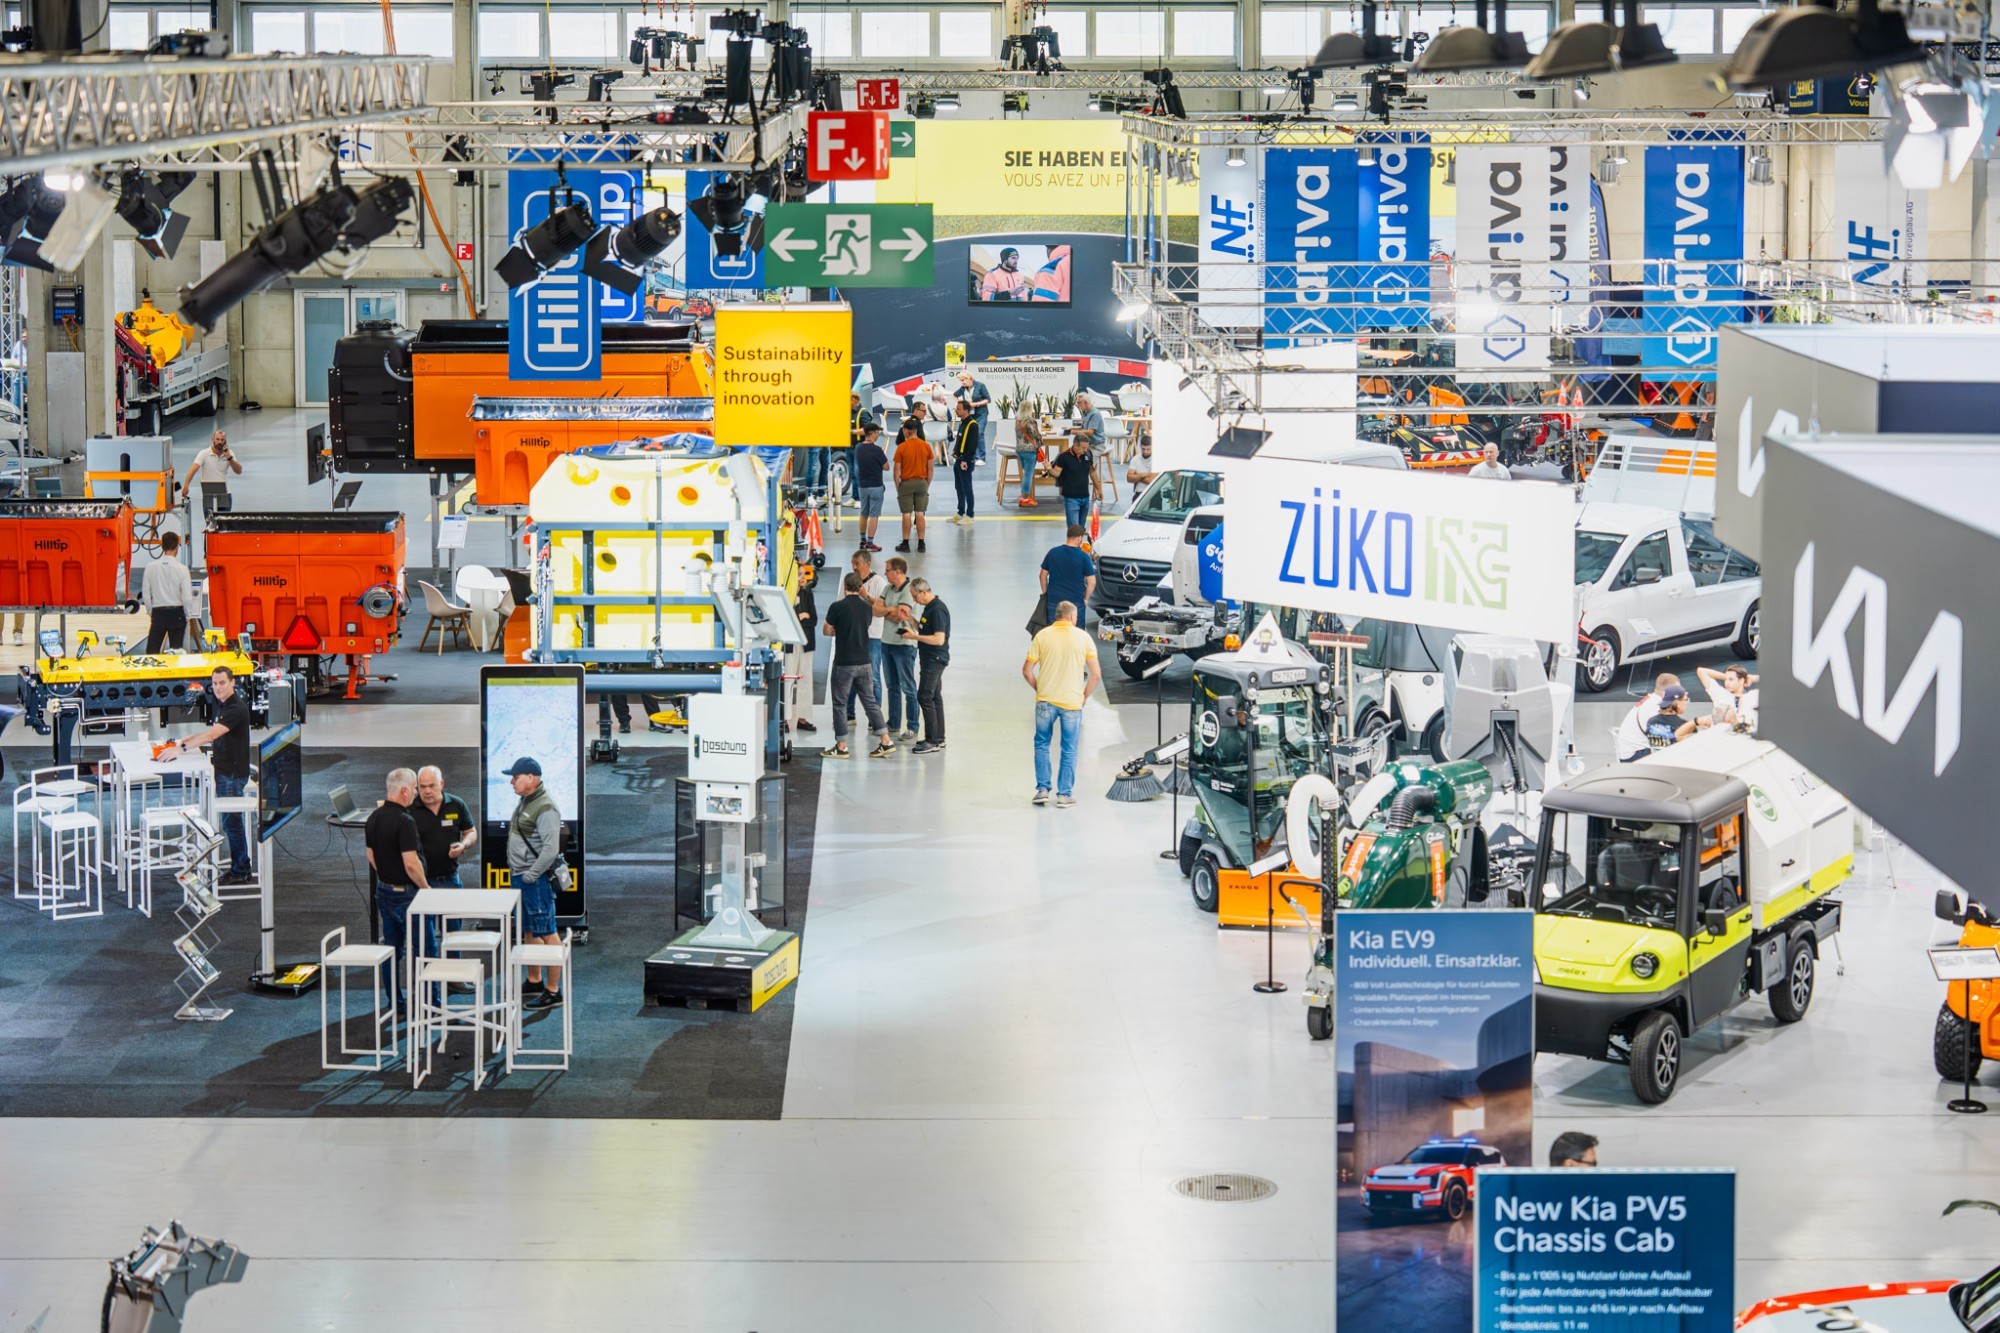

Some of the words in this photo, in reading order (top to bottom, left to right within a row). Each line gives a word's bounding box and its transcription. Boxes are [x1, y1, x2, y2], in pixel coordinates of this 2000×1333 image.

[860, 83, 869, 106] F
[881, 82, 890, 106] F
[817, 119, 846, 171] F
[876, 118, 884, 170] F
[1005, 151, 1032, 167] SIE
[1039, 151, 1104, 167] HABEN
[1005, 173, 1042, 187] VOUS
[1048, 173, 1084, 187] AVEZ
[1090, 173, 1110, 187] UN
[459, 245, 466, 258] F
[723, 346, 843, 364] Sustainability
[723, 369, 792, 386] through
[723, 391, 815, 405] innovation
[520, 437, 550, 449] Hilltip
[34, 538, 68, 552] Hilltip
[1279, 487, 1412, 598] ZÜKO
[253, 575, 287, 589] Hilltip
[702, 739, 747, 755] boschung
[1350, 930, 1384, 949] Kia
[1391, 930, 1436, 949] EV9
[1349, 955, 1431, 968] Individuell.
[1435, 954, 1522, 968] Einsatzklar.
[1494, 1195, 1562, 1222] New
[1571, 1195, 1617, 1222] Kia
[1627, 1195, 1687, 1222] PV5
[1493, 1226, 1606, 1253] Chassis
[1614, 1226, 1675, 1253] Cab
[1543, 1287, 1607, 1299] Anforderung
[1608, 1287, 1660, 1297] individuell
